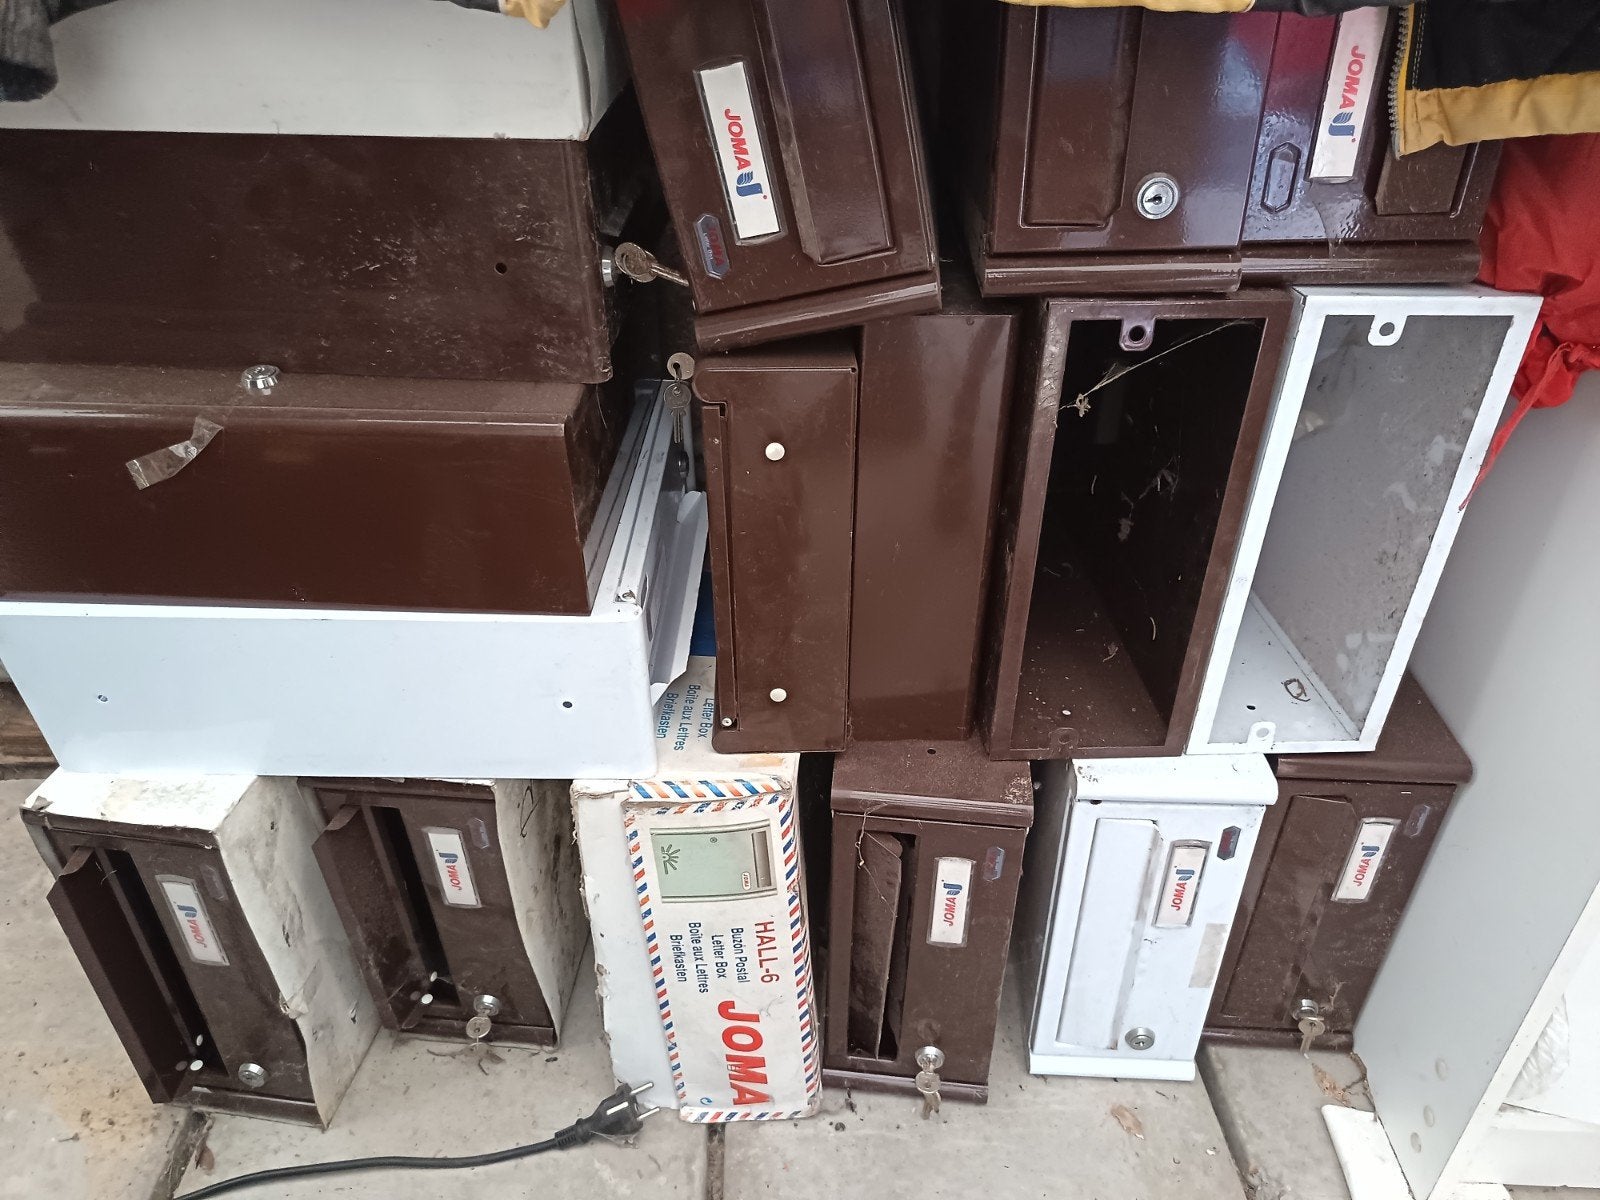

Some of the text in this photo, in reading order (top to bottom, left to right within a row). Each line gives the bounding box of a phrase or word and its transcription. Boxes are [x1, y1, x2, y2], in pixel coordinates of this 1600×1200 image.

[1339, 45, 1365, 110] JOMA
[724, 108, 751, 170] JOMA
[656, 693, 679, 739] Briefkasten
[682, 706, 693, 720] aux
[698, 698, 714, 738] Letter Box
[674, 723, 692, 750] Lettres
[446, 865, 462, 890] JOMA
[1353, 859, 1371, 887] JOMA
[943, 897, 957, 927] JOMA
[1171, 882, 1187, 911] JOMA
[187, 919, 207, 948] JOMA
[670, 934, 688, 982] Briefkasten
[692, 946, 704, 961] aux
[711, 935, 728, 978] Letter Box
[731, 928, 750, 983] Buzón Postal
[755, 921, 780, 983] HALL-6
[696, 964, 709, 993] Lettres
[717, 1000, 773, 1105] JOMA
